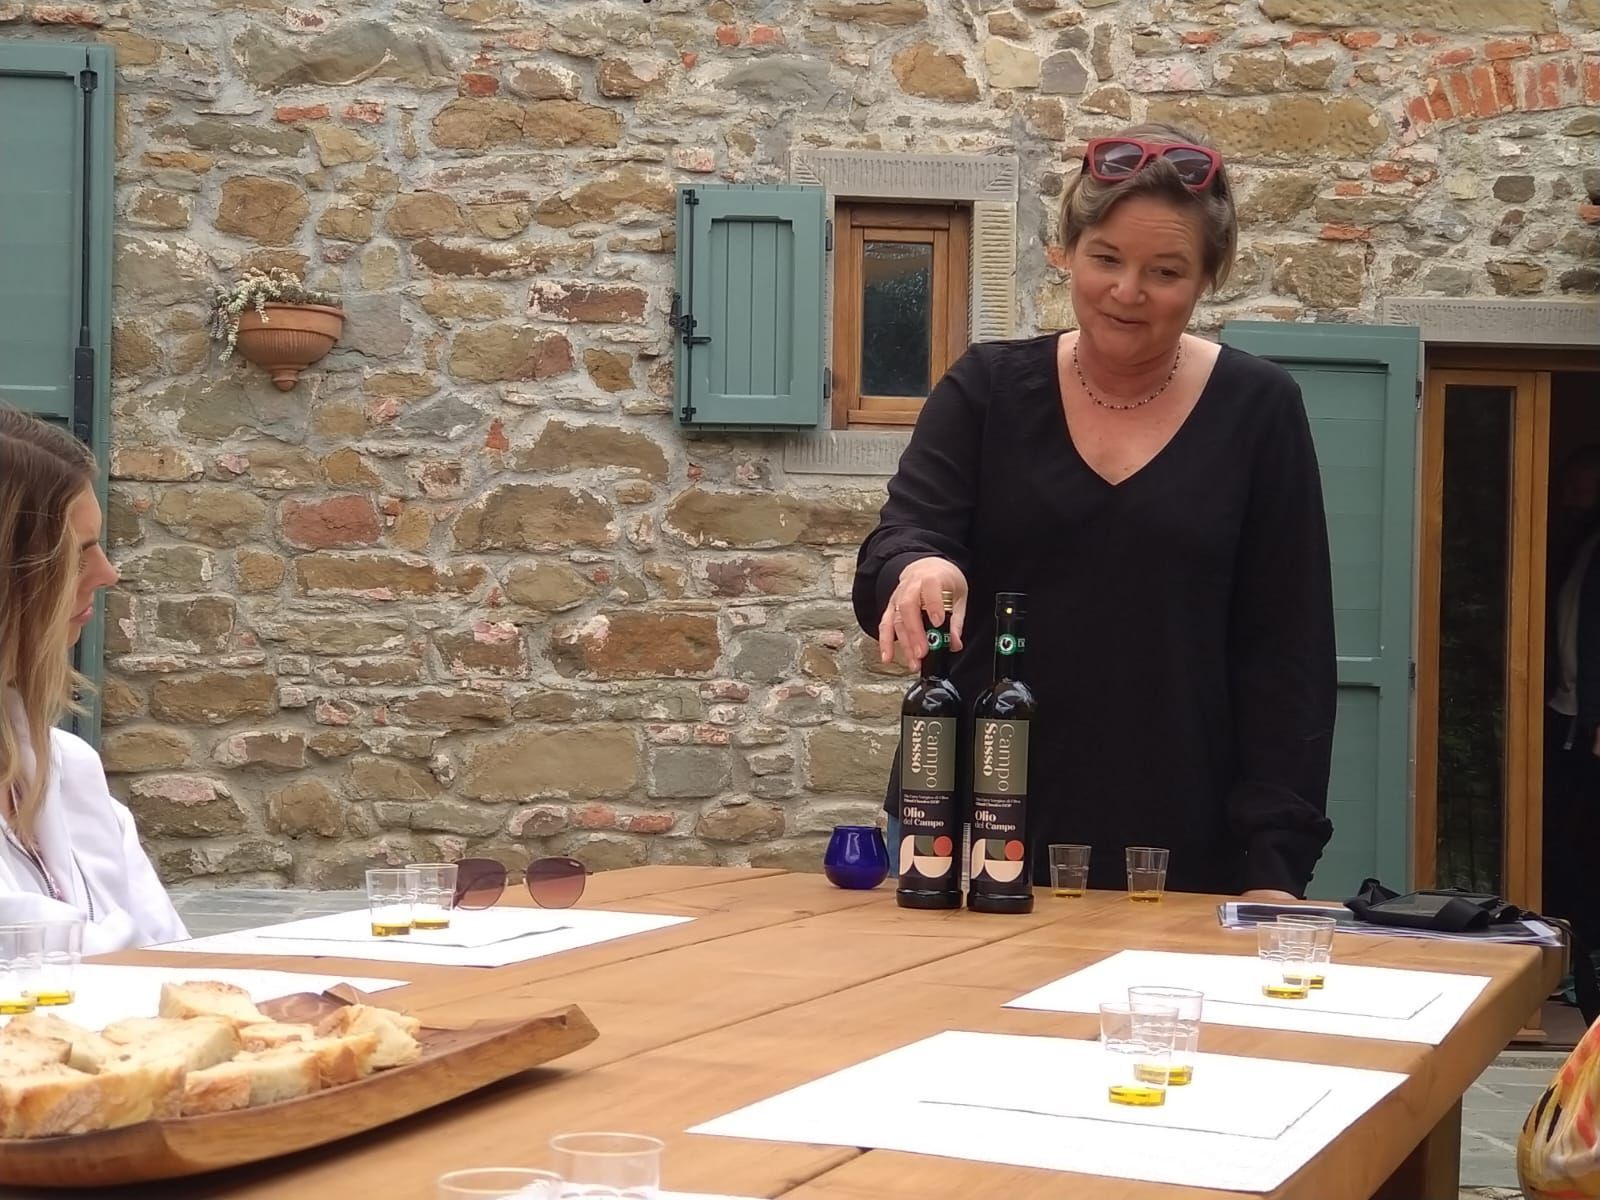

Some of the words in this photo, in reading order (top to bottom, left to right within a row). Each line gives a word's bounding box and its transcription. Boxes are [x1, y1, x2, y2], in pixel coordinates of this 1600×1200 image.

[911, 719, 926, 774] Sasso
[923, 720, 943, 788] Campo
[983, 722, 998, 777] Sasso
[994, 723, 1015, 792] Campo
[903, 806, 925, 818] Olio
[914, 819, 944, 829] Campo
[975, 810, 997, 822] Olio
[985, 822, 1016, 833] Campo
